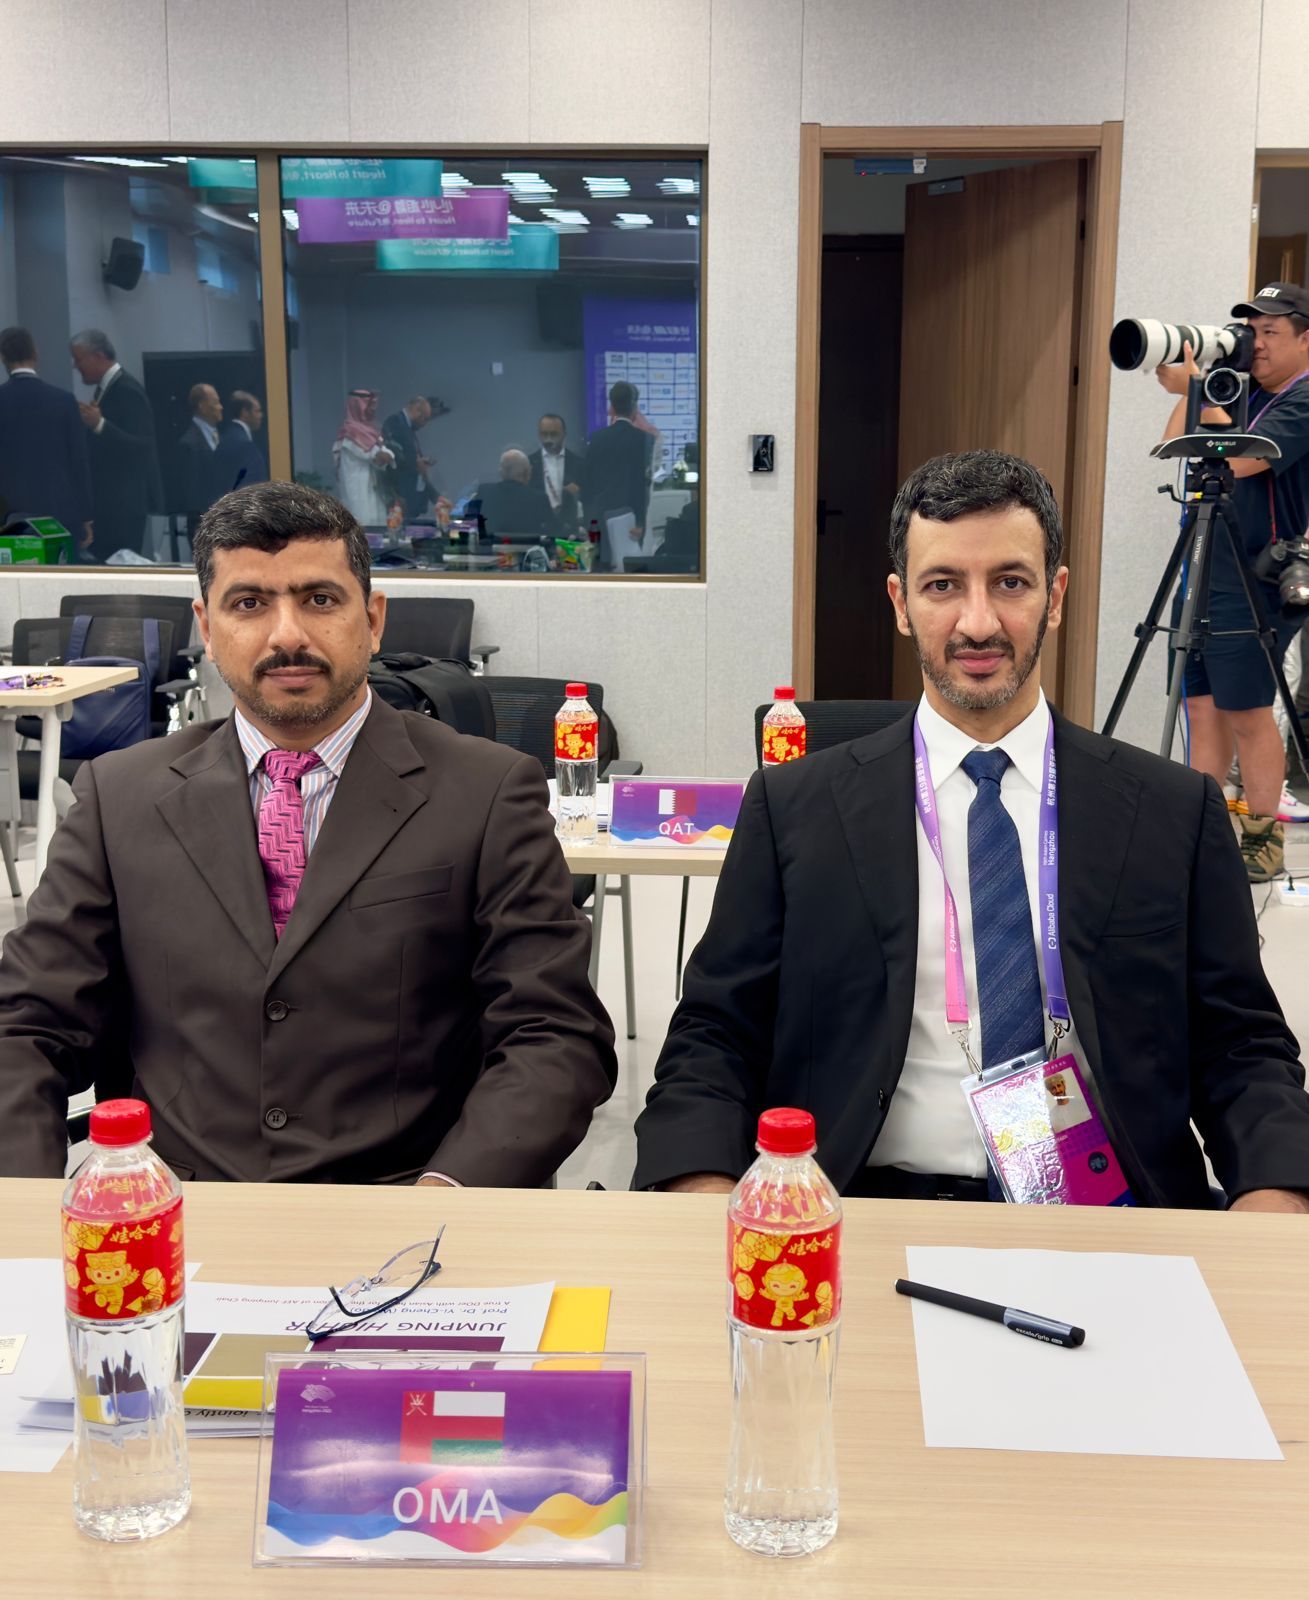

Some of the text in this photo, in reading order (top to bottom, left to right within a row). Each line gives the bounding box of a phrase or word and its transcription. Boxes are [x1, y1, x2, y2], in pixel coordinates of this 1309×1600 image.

[658, 821, 695, 836] QAT
[1048, 830, 1056, 866] Hangzhou
[1046, 893, 1056, 937] Alibaba Cloud
[109, 1219, 162, 1244] 娃哈哈
[787, 1232, 833, 1256] 娃哈哈
[397, 1322, 508, 1332] JUMPING
[392, 1486, 504, 1525] OMA
